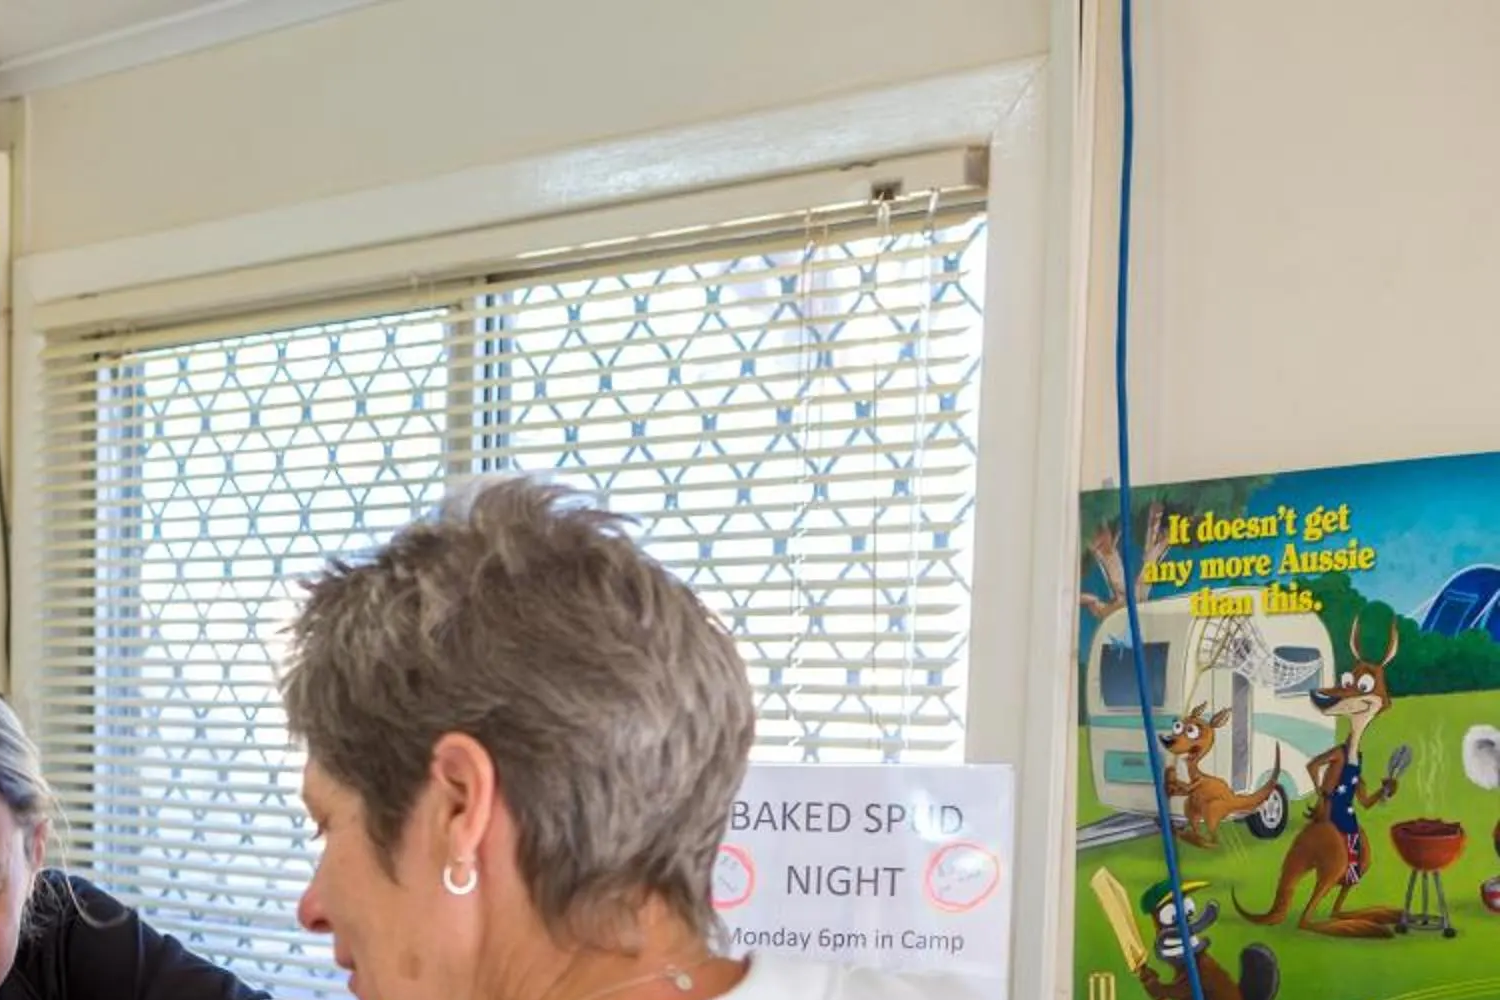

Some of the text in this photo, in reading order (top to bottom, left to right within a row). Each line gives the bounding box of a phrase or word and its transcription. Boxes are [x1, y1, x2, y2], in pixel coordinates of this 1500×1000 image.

[1168, 503, 1350, 545] It doesn't get
[1144, 540, 1374, 587] any more Aussie
[1190, 579, 1323, 617] than this.
[731, 801, 851, 832] BAKED
[787, 865, 905, 897] NIGHT
[818, 928, 867, 951] 6pm
[875, 930, 893, 948] in
[901, 930, 964, 953] Camp
